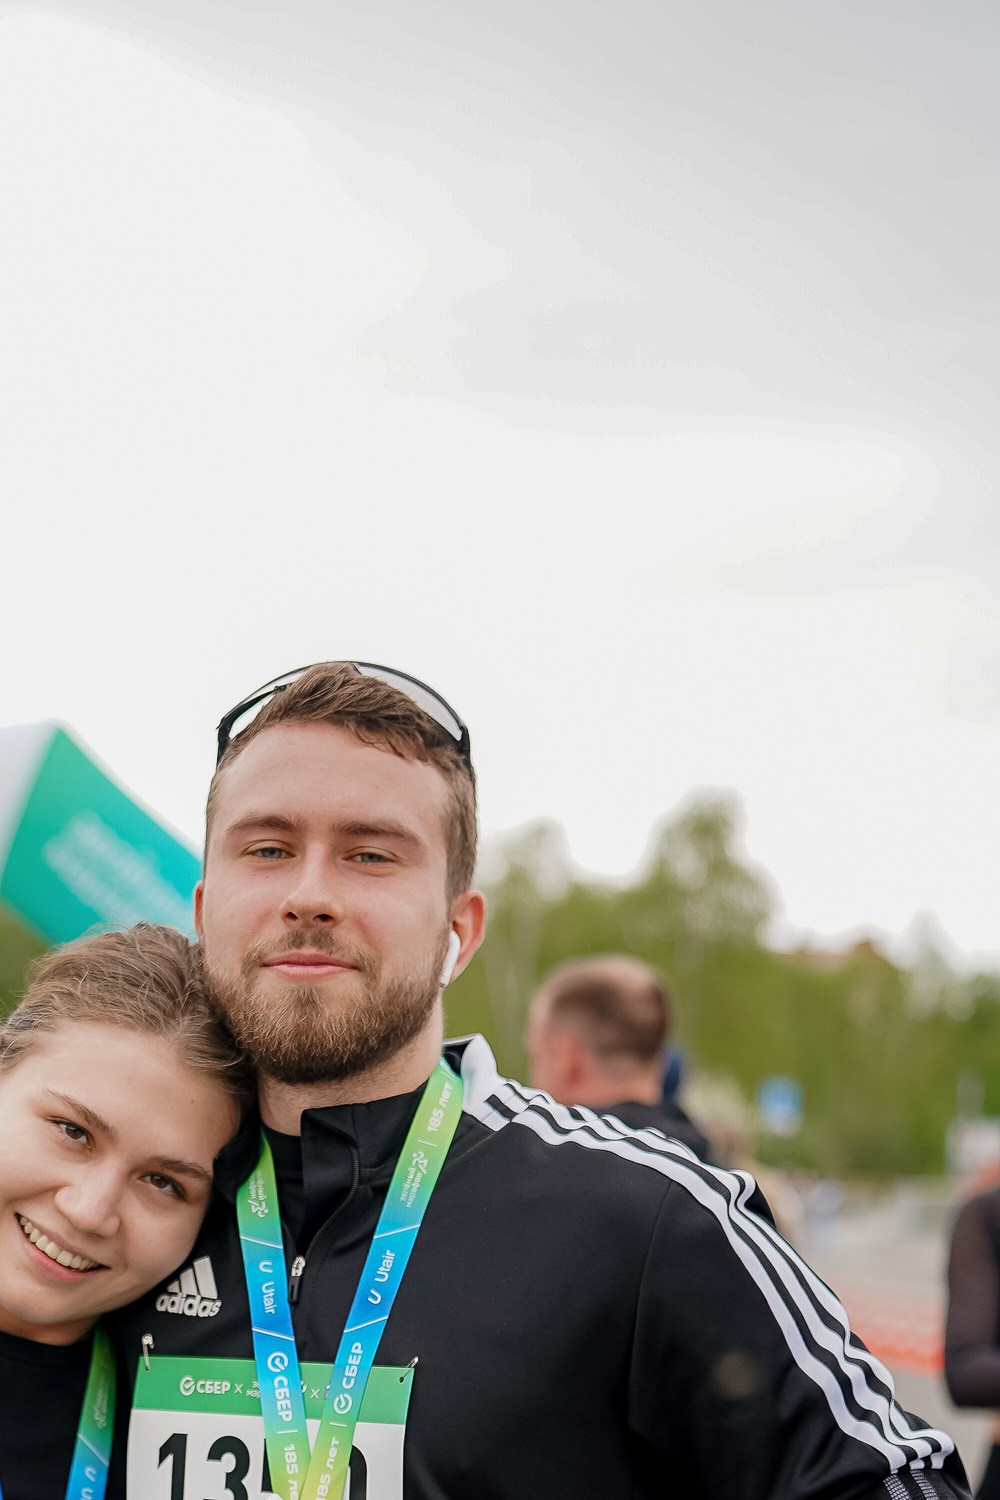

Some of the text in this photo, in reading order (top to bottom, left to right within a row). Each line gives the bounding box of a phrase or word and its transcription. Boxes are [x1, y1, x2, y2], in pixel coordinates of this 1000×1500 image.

[427, 1082, 453, 1132] 185 лет
[374, 1249, 396, 1283] Utair
[155, 1292, 222, 1317] adidas
[261, 1281, 276, 1315] Utair
[342, 1342, 364, 1390] СБЕР
[195, 1379, 232, 1396] СБЕР
[273, 1375, 294, 1423] СБЕР
[284, 1443, 298, 1475] 185
[326, 1437, 340, 1470] лет
